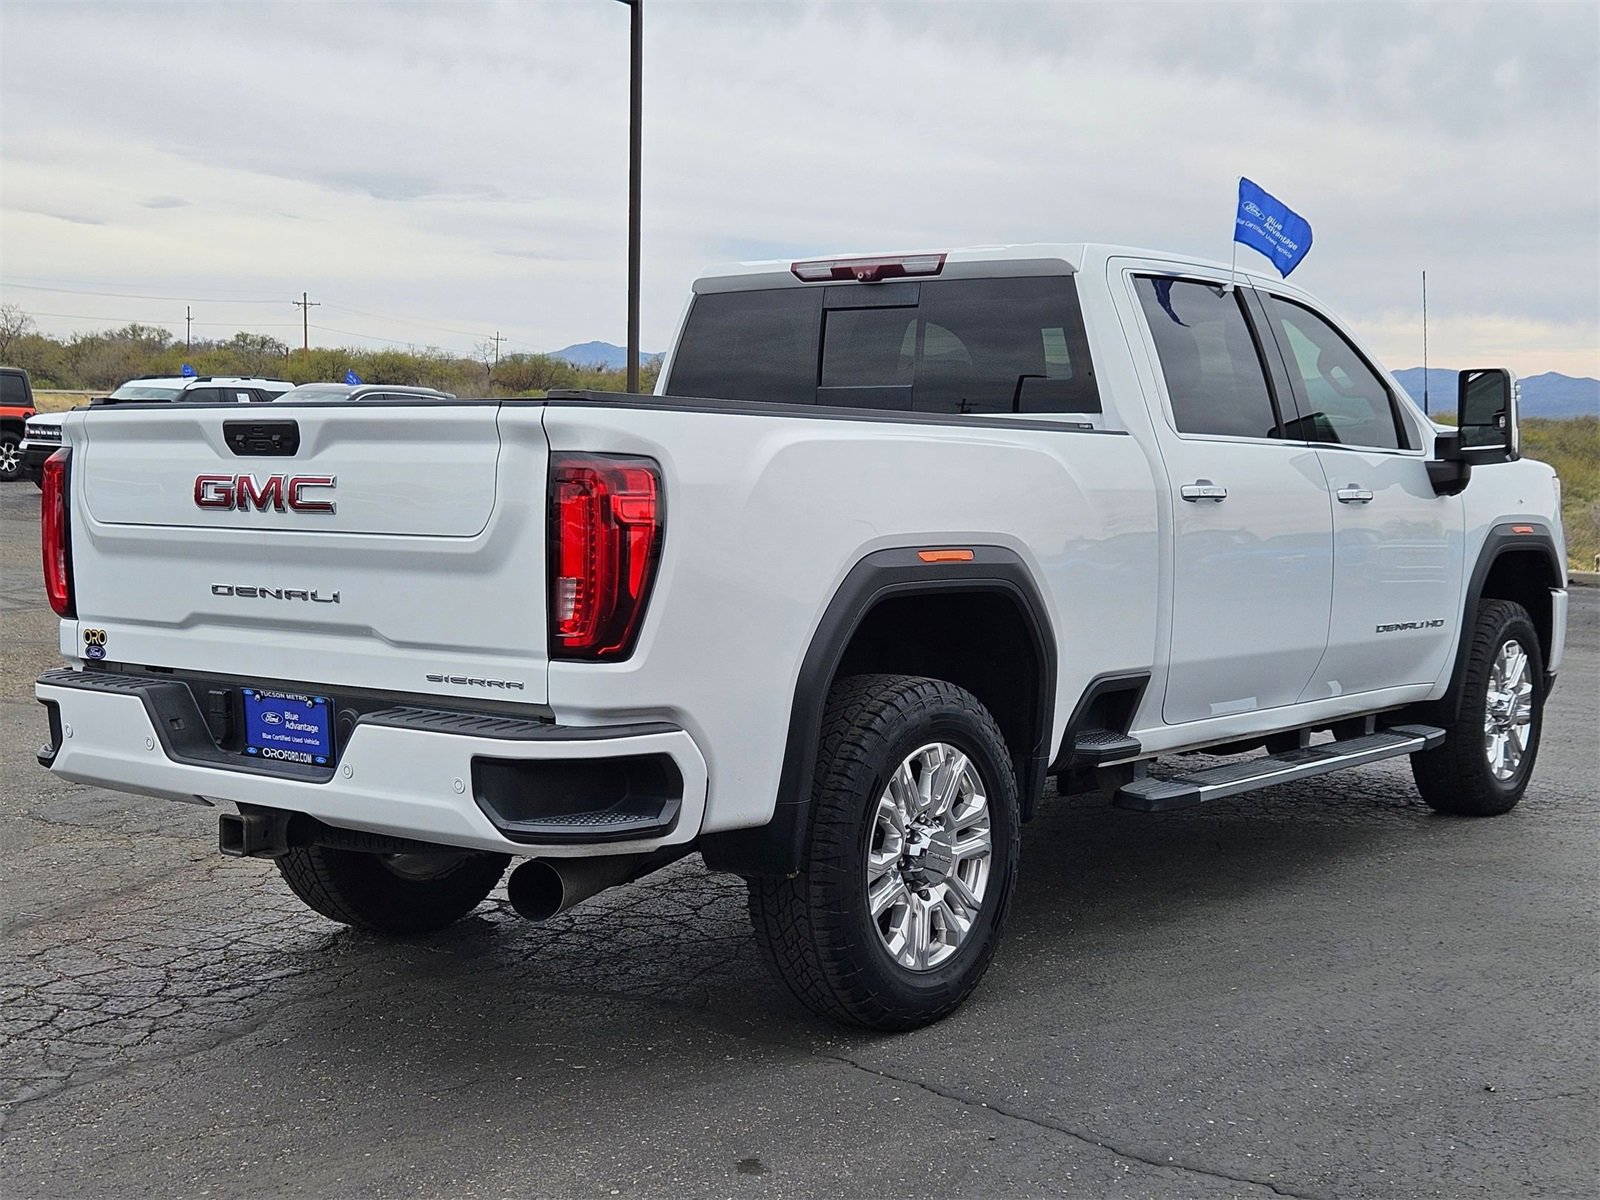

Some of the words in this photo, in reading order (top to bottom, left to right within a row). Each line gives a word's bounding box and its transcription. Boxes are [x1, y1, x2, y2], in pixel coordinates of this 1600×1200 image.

[1266, 216, 1283, 231] Blue
[1264, 222, 1298, 250] Advantage
[194, 473, 336, 515] GMC
[211, 583, 340, 604] DENALI
[1376, 621, 1424, 633] DENALI
[1425, 618, 1444, 628] HD
[83, 628, 107, 645] ORO
[426, 674, 524, 690] SIERRA
[260, 690, 285, 699] TUCSON
[286, 694, 308, 702] METRO
[263, 712, 282, 724] Ford
[284, 711, 299, 721] Blue
[285, 721, 319, 734] Advantage
[262, 731, 272, 740] Blue
[272, 733, 291, 742] Certified
[292, 736, 303, 744] Used
[304, 737, 320, 746] Vehicle
